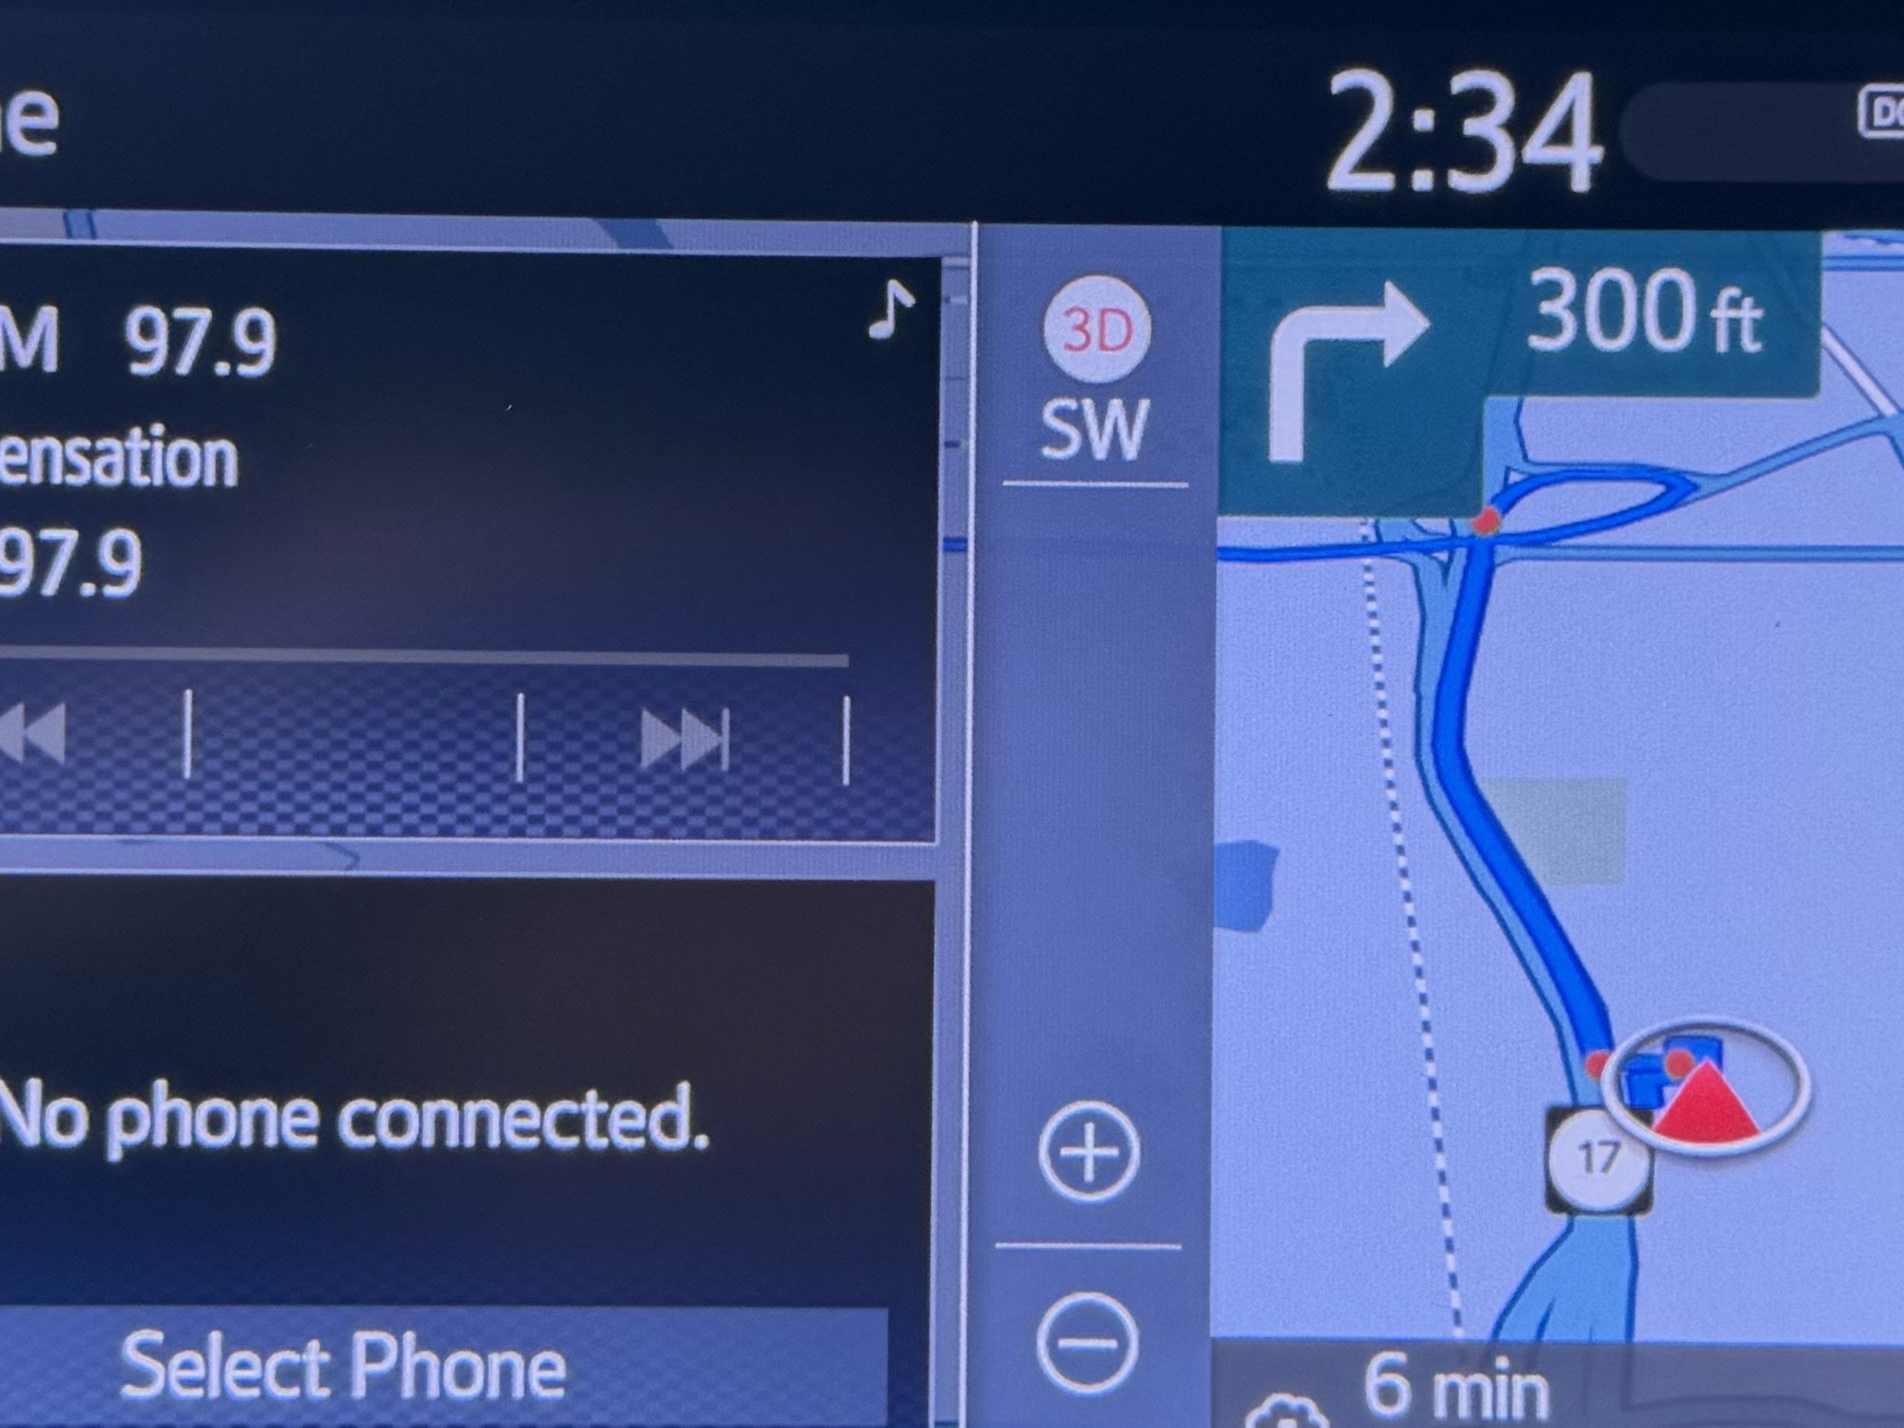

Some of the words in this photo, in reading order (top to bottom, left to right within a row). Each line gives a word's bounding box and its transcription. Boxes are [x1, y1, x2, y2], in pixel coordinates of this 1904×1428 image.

[1326, 68, 1604, 193] 2:34
[125, 305, 276, 377] 97.9
[1063, 305, 1134, 353] 3D
[1041, 397, 1150, 461] SW
[107, 1077, 318, 1163] phone
[339, 1081, 710, 1150] connected.
[1577, 1139, 1621, 1176] 17
[120, 1328, 330, 1401] Select
[352, 1331, 566, 1400] Phone
[1362, 1351, 1411, 1417] 6
[1434, 1356, 1550, 1422] min
